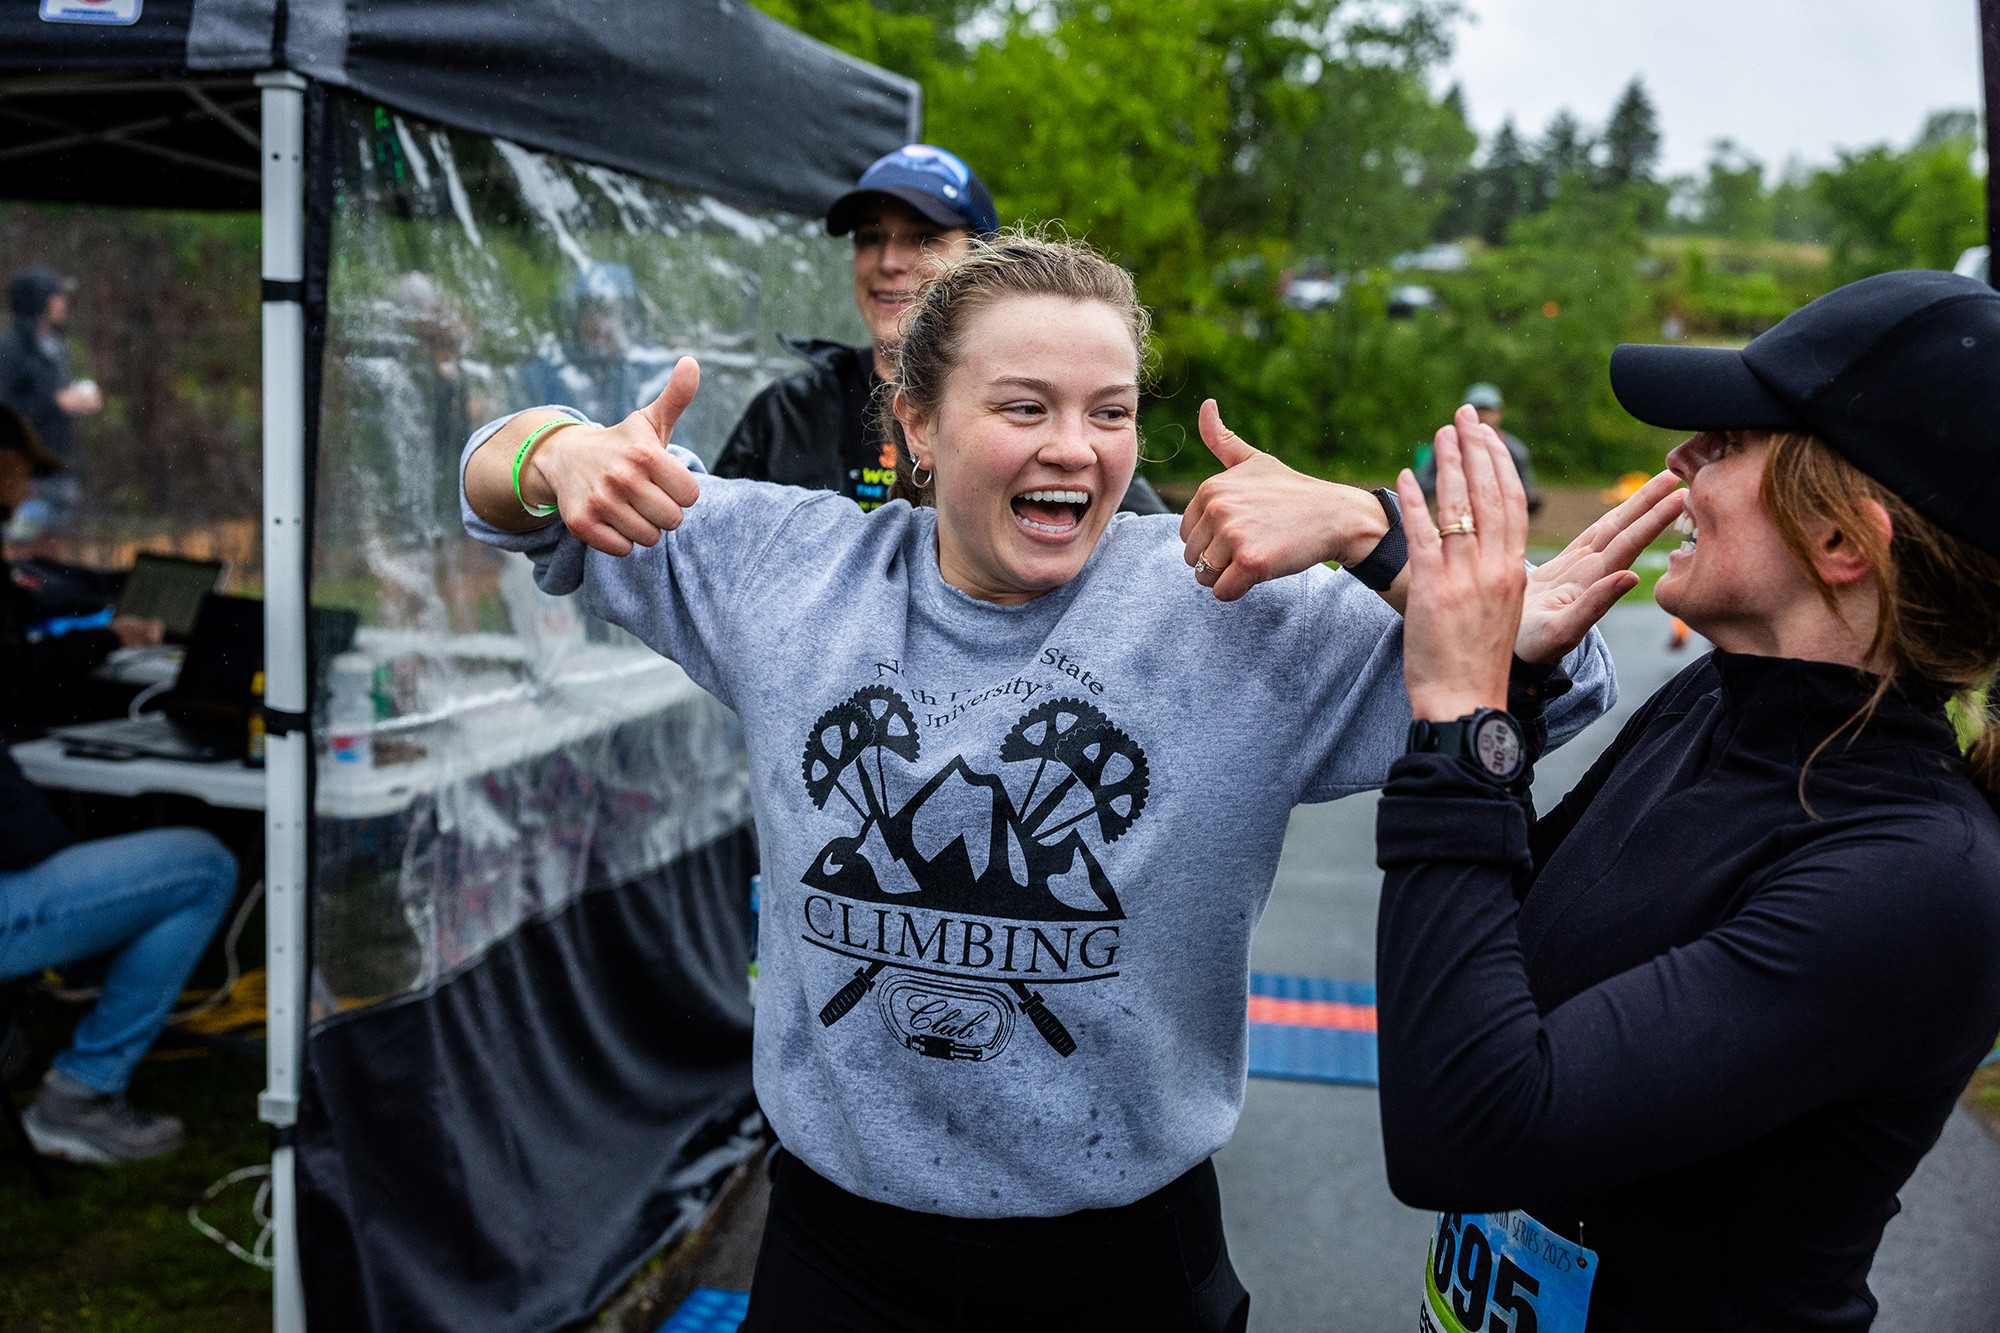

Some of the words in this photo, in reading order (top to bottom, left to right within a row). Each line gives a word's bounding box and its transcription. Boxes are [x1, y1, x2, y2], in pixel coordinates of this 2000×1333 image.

[1039, 647, 1104, 696] State
[803, 895, 1120, 974] CLIMBING
[906, 994, 990, 1039] Club
[1434, 1211, 1540, 1333] 695
[1512, 1216, 1540, 1254] SERIES
[1542, 1238, 1571, 1273] 2025
